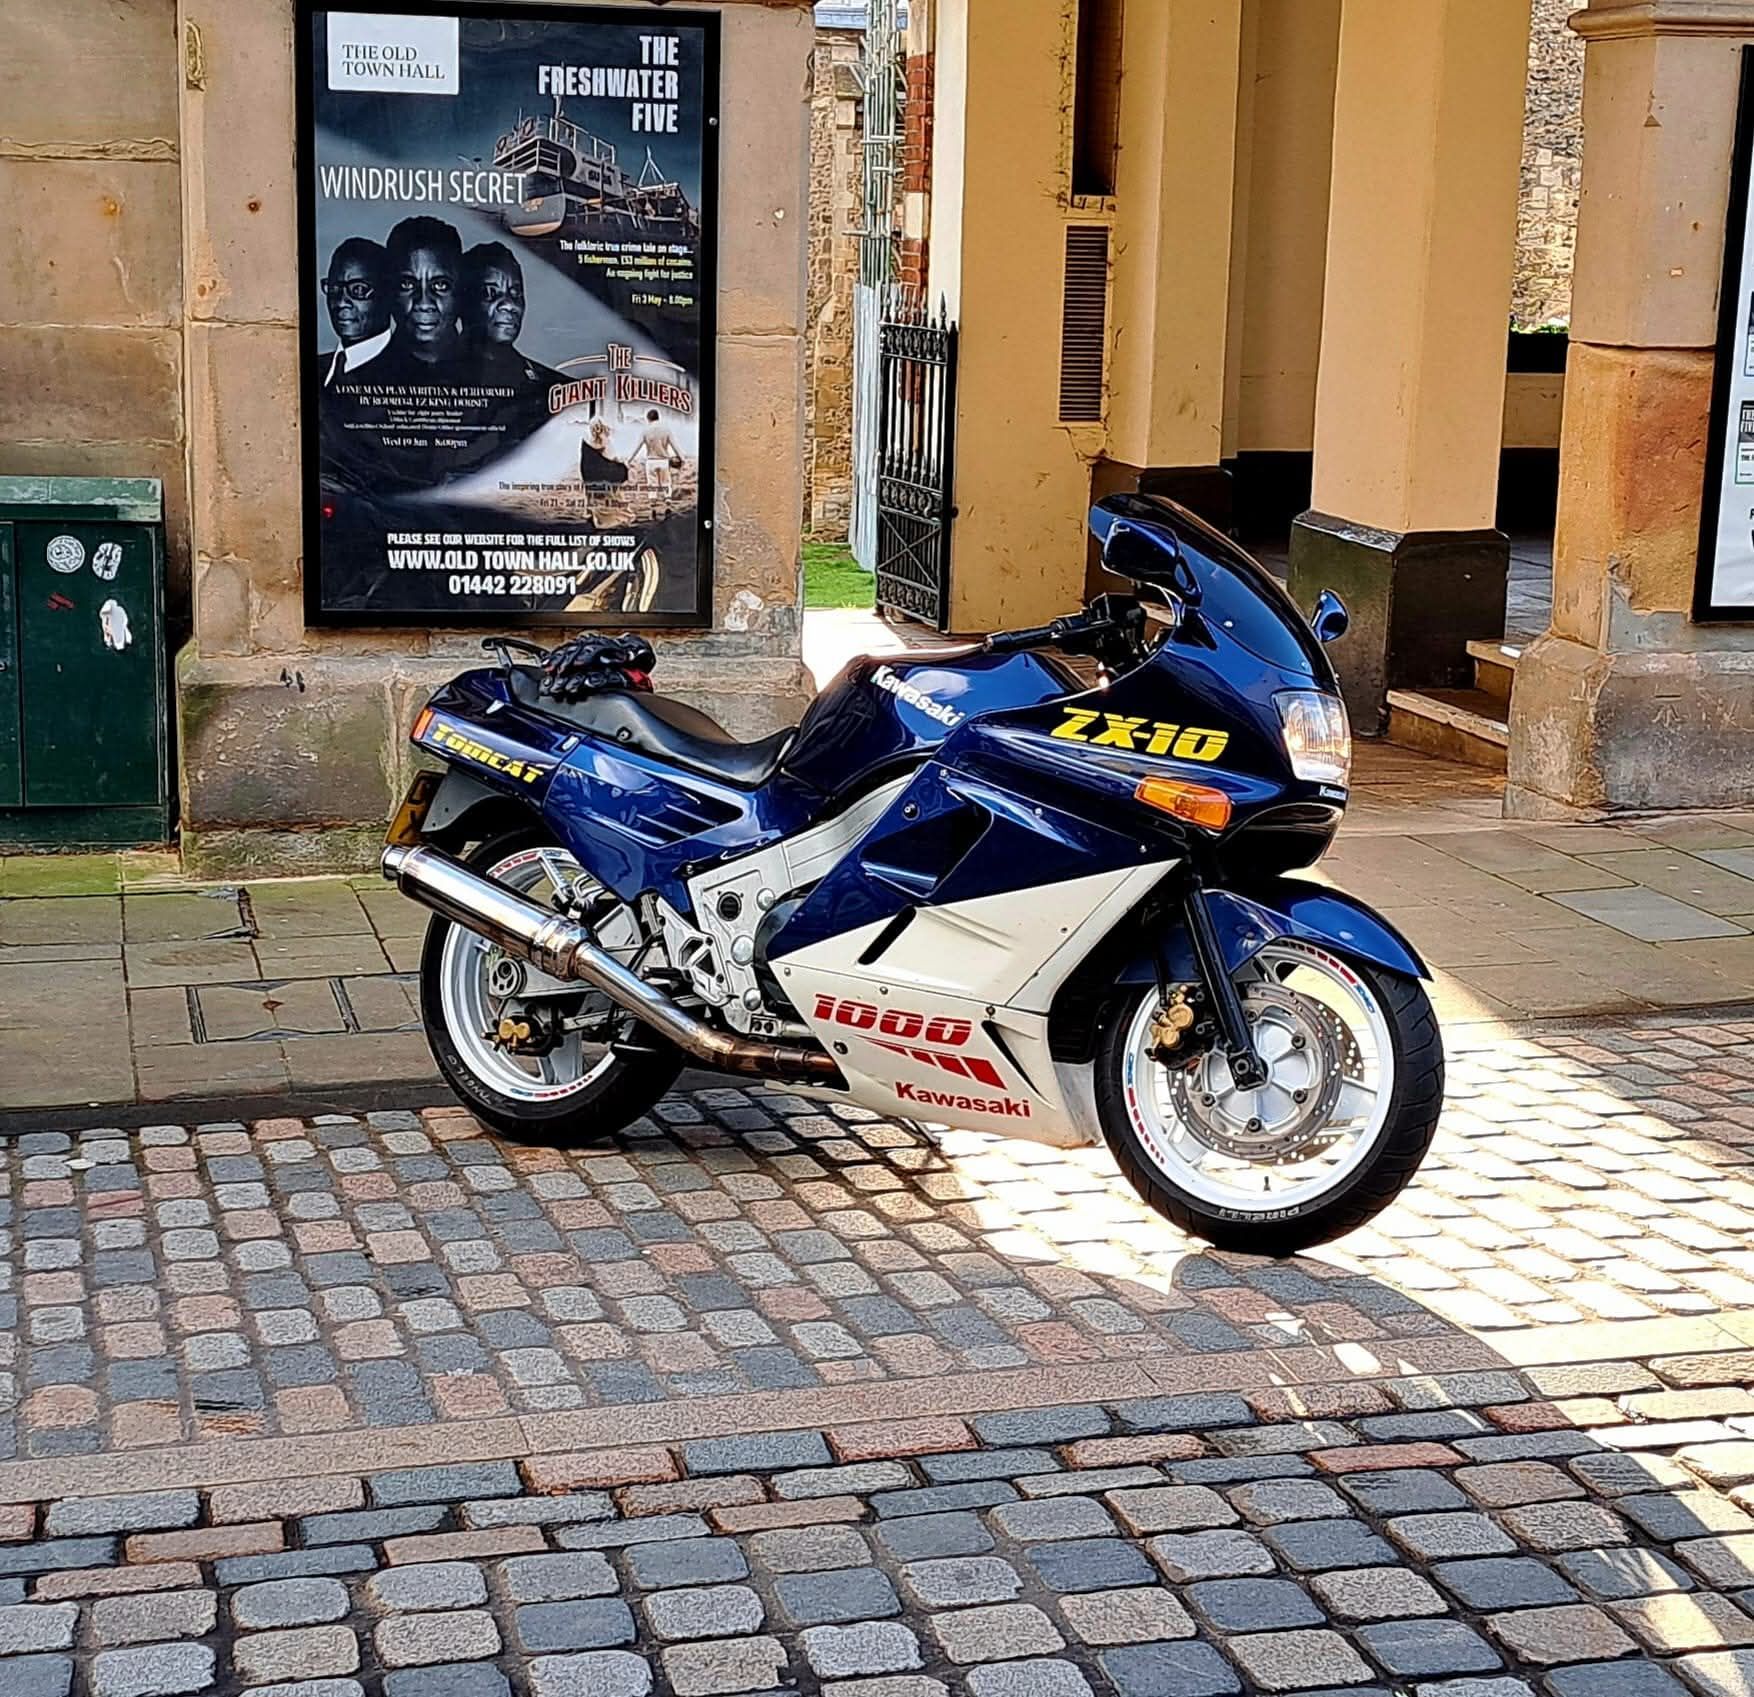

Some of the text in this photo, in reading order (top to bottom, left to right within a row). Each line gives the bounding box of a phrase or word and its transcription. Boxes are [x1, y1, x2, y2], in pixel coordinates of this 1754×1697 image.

[342, 44, 417, 61] THE OLD
[640, 35, 679, 65] THE
[342, 61, 445, 79] TOWN HALL
[538, 64, 678, 99] FRESHWATER
[632, 102, 678, 133] FIVE
[320, 166, 526, 204] WINDRUSH SECRET
[560, 239, 573, 251] The
[605, 241, 620, 252] true
[621, 241, 642, 253] crime
[643, 242, 656, 253] tale
[657, 244, 667, 254] on
[578, 254, 583, 264] 5
[634, 256, 657, 266] million
[657, 255, 665, 266] of
[644, 268, 659, 280] fight
[660, 268, 670, 279] for
[671, 268, 694, 281] justice
[631, 294, 641, 305] Fri
[647, 294, 662, 307] May
[608, 343, 632, 371] THE
[548, 373, 692, 414] GIANT KILLERS
[383, 436, 401, 447] Wed
[387, 533, 635, 547] PLEASE SEE OUR WEBSITE FOR THE FULL LIST OF SHOWS
[388, 549, 635, 571] WWW.OLD TOWN HALL.CO.UK
[449, 575, 577, 596] 01442 228091
[869, 665, 966, 727] Kawasaki
[1050, 706, 1229, 763] ZX-10
[431, 723, 544, 783] TOMCAT
[813, 992, 973, 1047] 1000
[894, 1081, 1031, 1119] Kawasaki
[1218, 1206, 1300, 1222] PIRELLI
